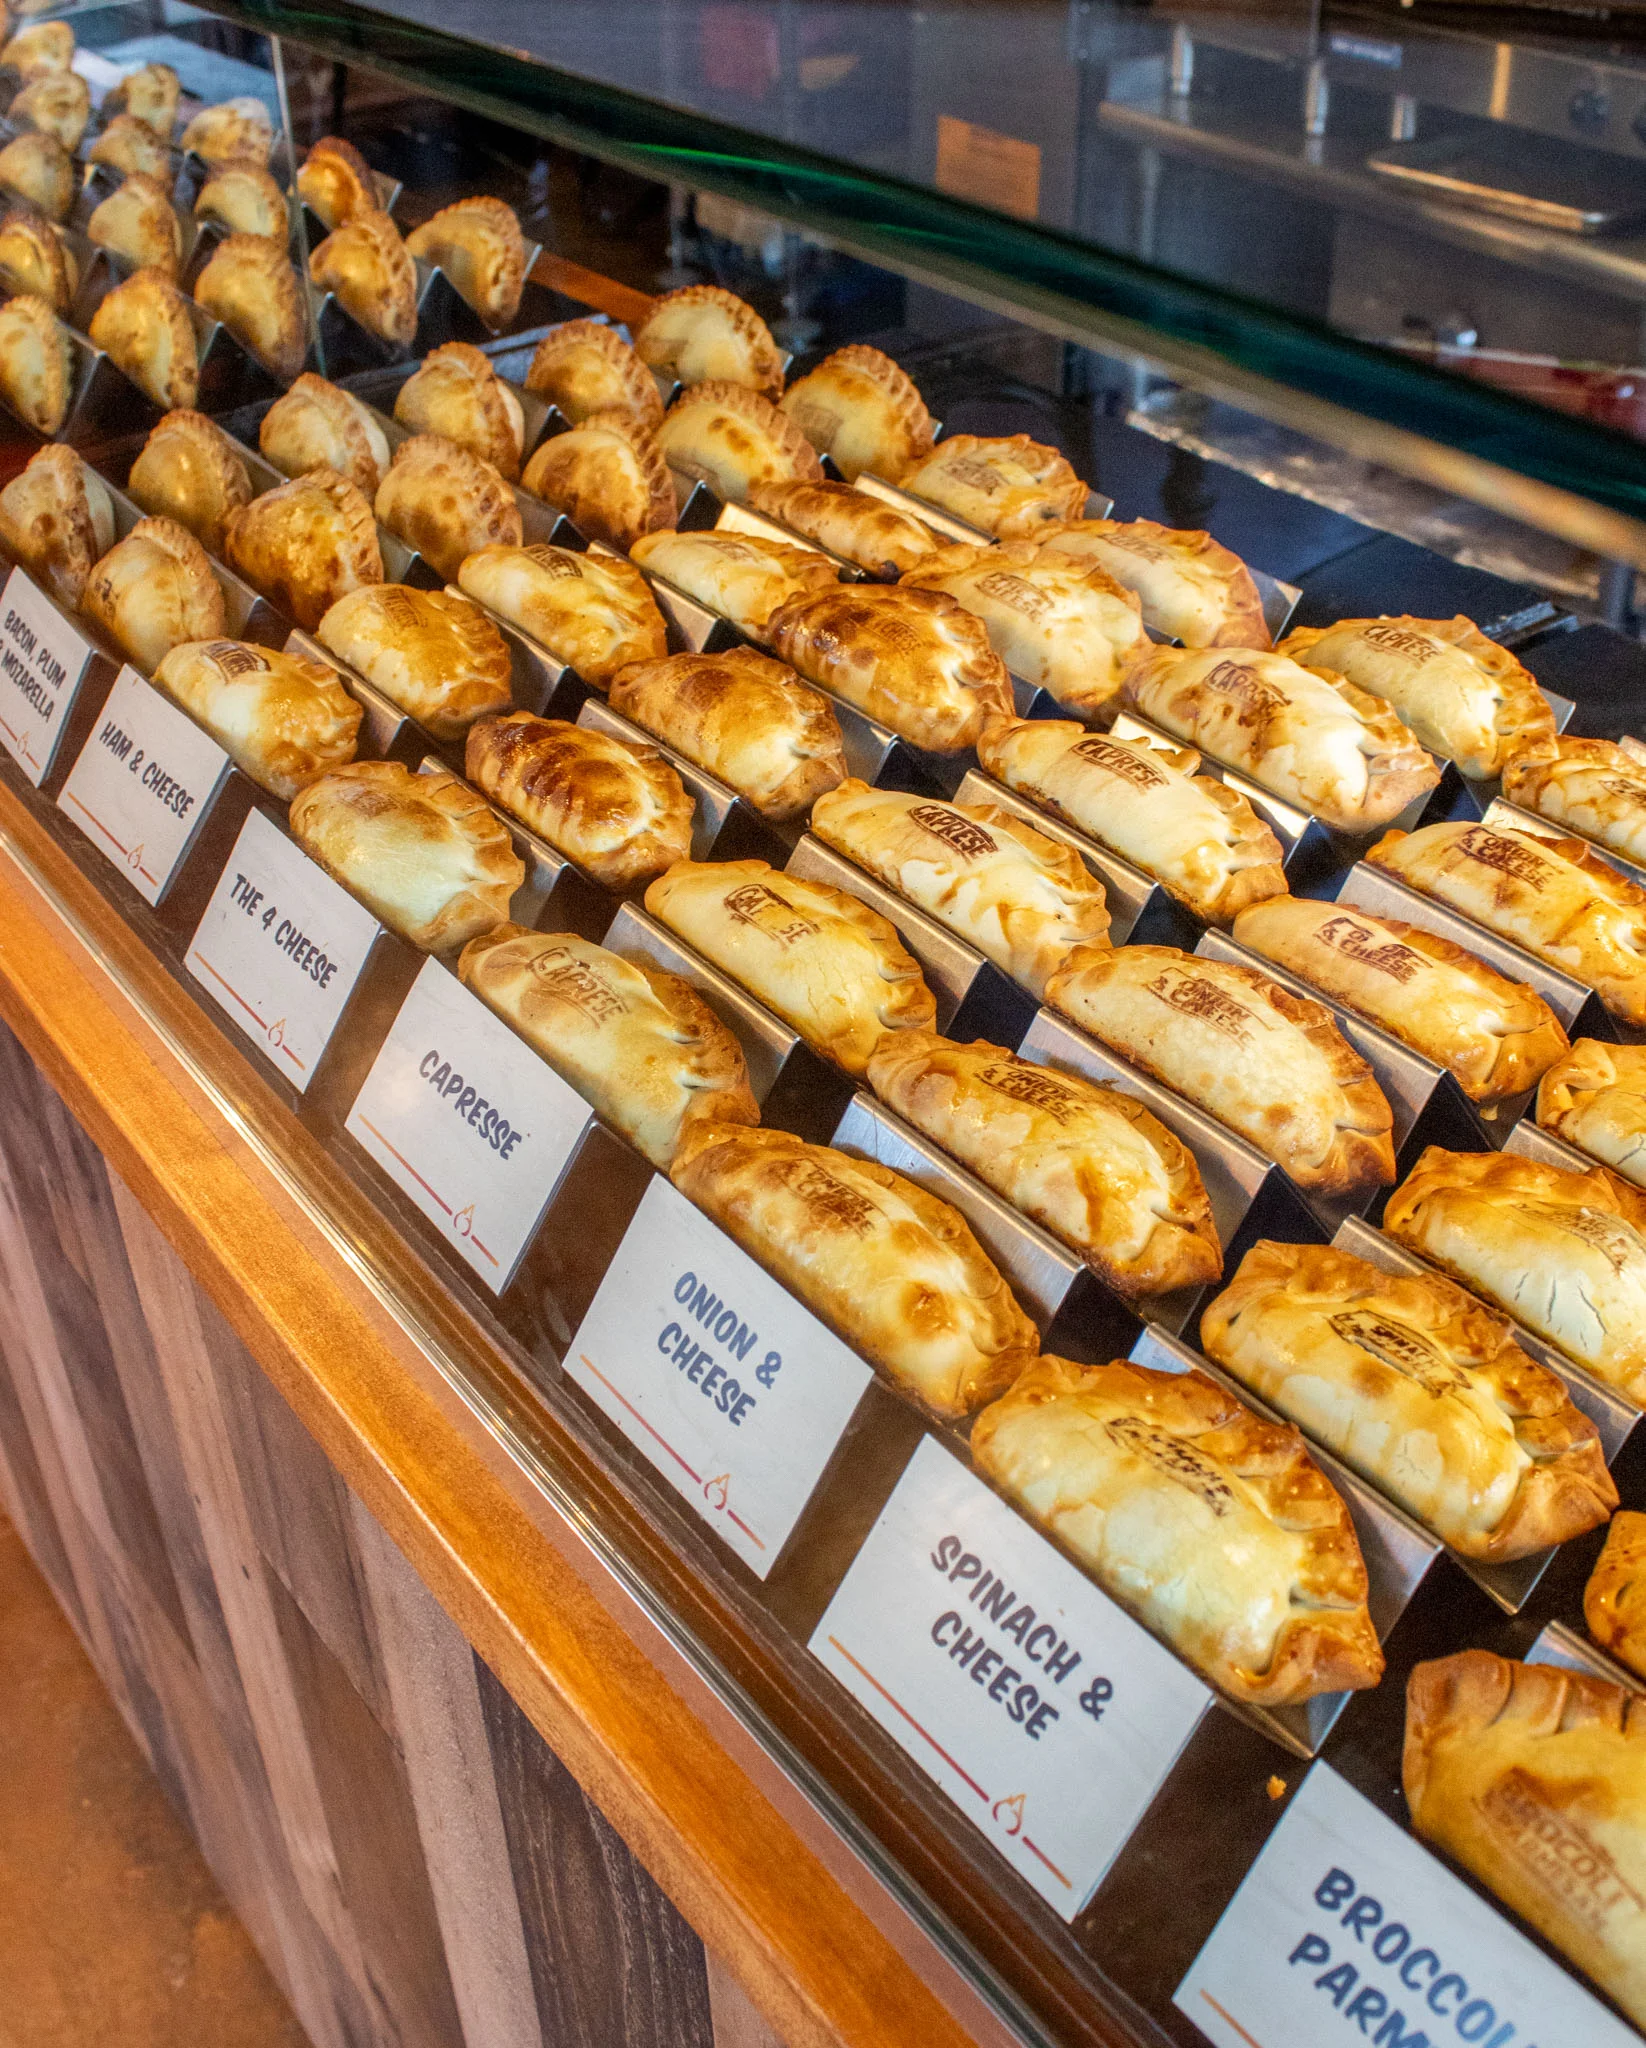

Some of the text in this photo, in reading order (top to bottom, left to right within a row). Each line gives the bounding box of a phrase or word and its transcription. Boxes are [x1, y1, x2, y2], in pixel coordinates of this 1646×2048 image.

[1, 648, 55, 723] MOZARELLA
[4, 609, 67, 691] BACON, PLUM
[1208, 665, 1284, 718] CAPR
[1364, 626, 1440, 662] CAPRESE
[99, 721, 195, 820] HAM & CHEESE
[1076, 739, 1165, 790] CAPRESE
[913, 804, 995, 859] CAPRESE
[228, 872, 338, 990] THE 4 CHEESE
[735, 888, 812, 944] CASE
[418, 1049, 523, 1161] CAPRESSE
[657, 1322, 757, 1427] CHEESE
[673, 1271, 784, 1390] ONION &
[930, 1535, 1115, 1721] SPINACH &
[930, 1611, 1060, 1741] CHEESE
[1314, 1867, 1538, 2048] BROCCO
